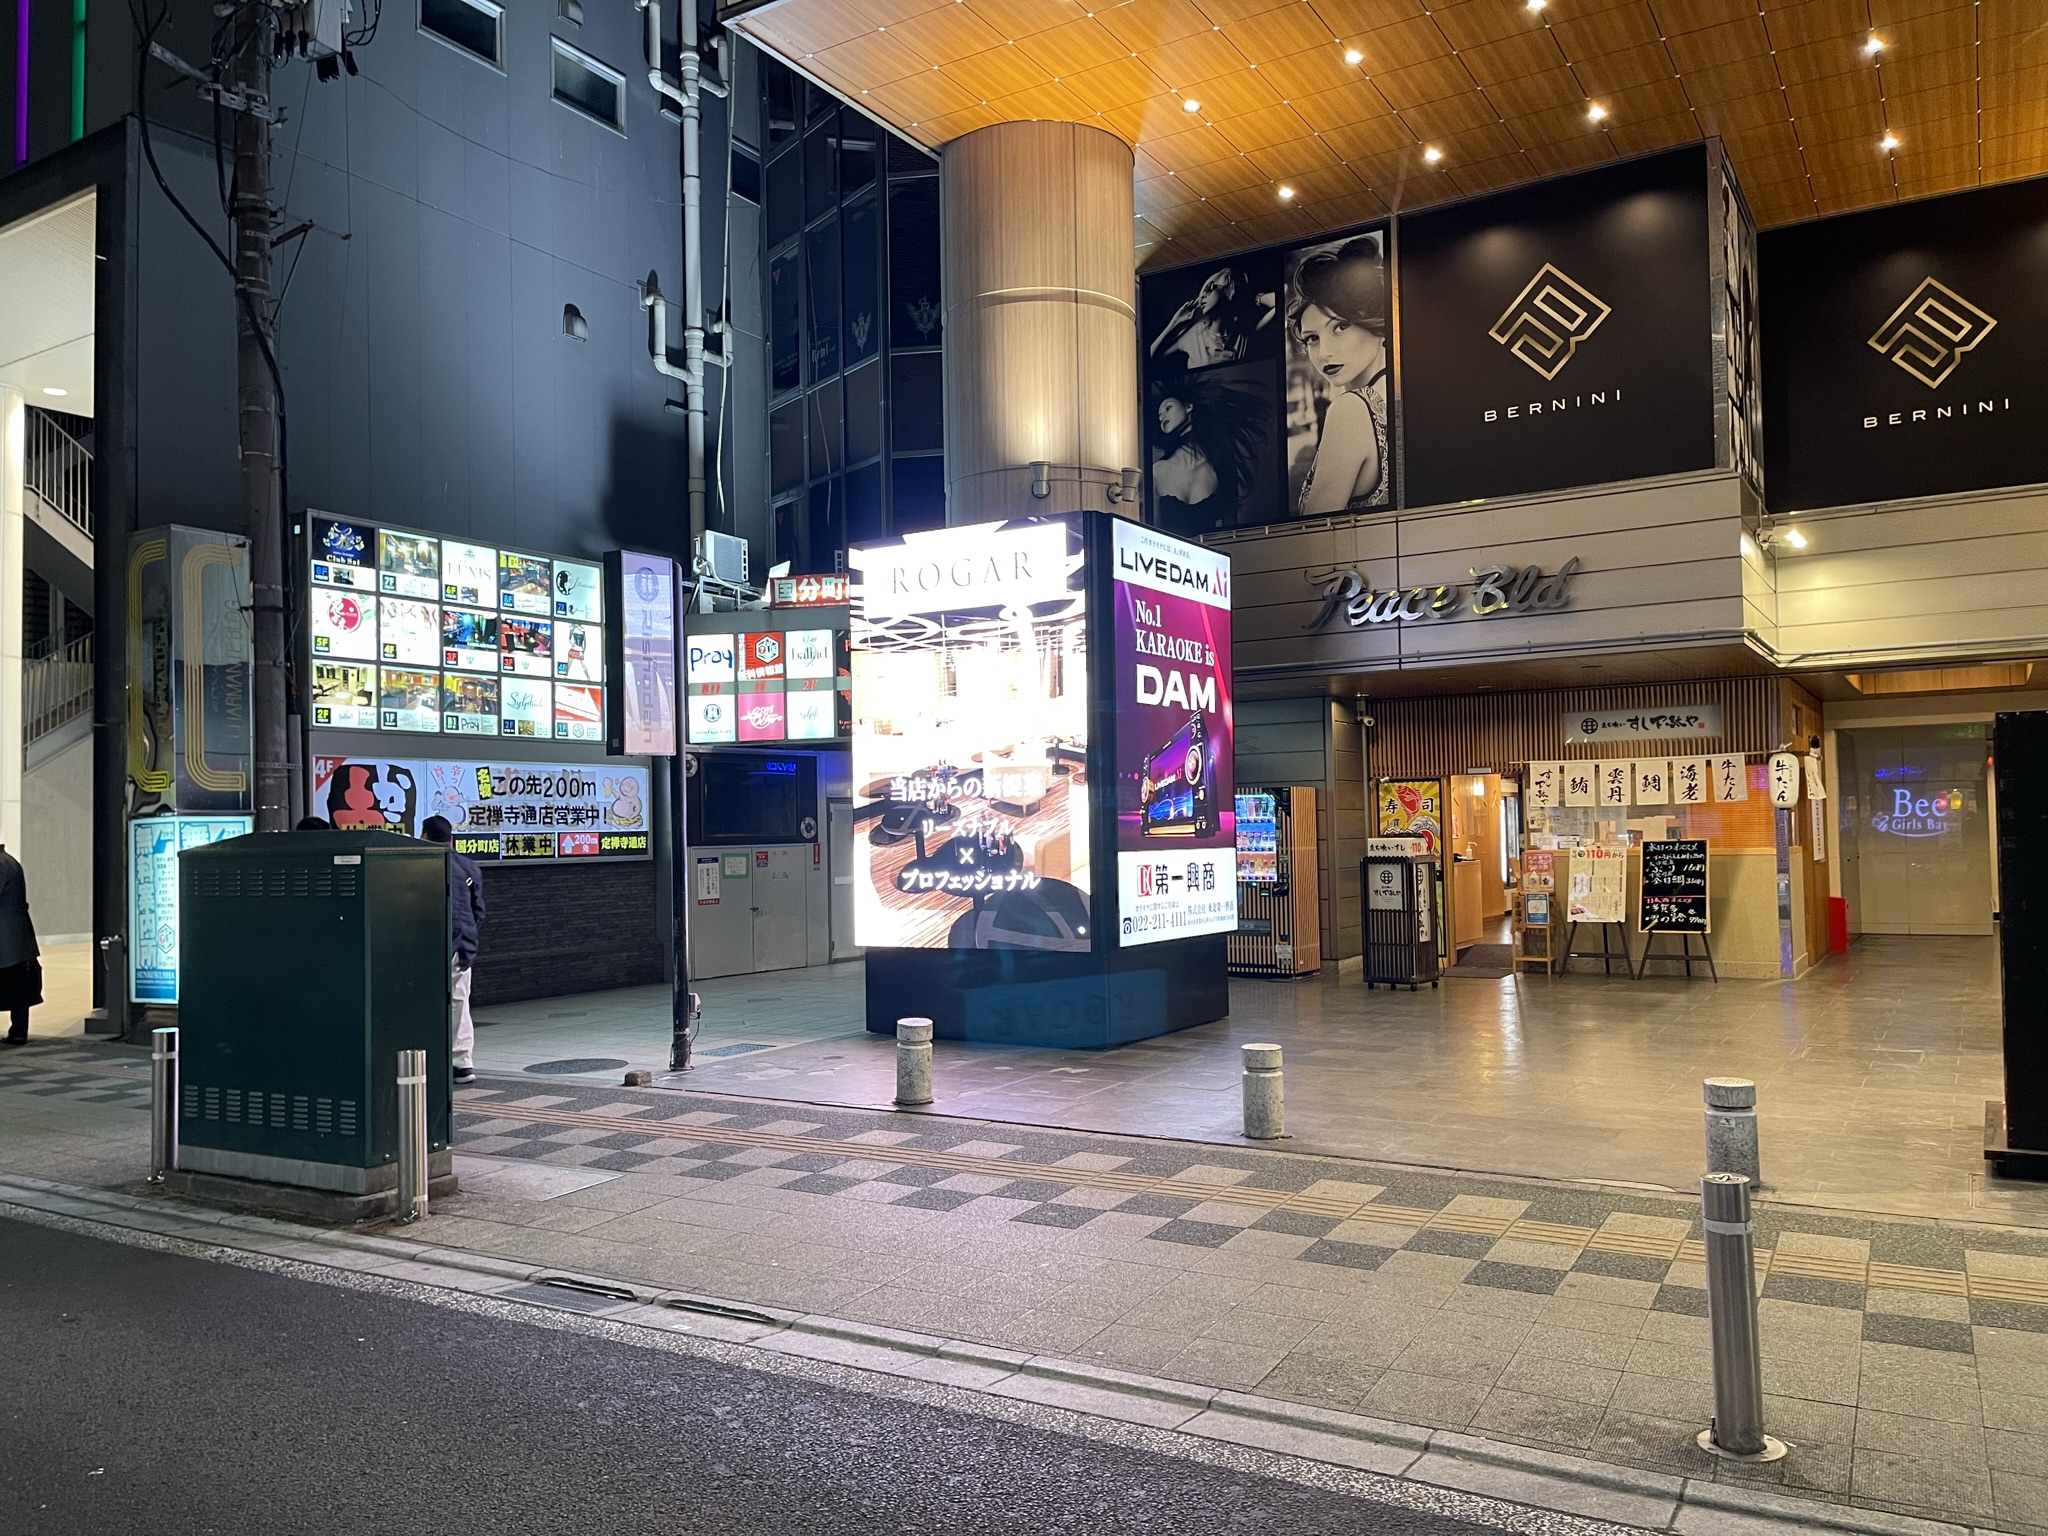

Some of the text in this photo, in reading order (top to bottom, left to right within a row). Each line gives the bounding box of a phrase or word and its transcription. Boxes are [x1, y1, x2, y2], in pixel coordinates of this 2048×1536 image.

[1484, 389, 1620, 422] BERNINI
[1863, 398, 2009, 429] BERNINI
[893, 551, 1032, 594] ROGAR
[1121, 547, 1227, 598] LIVEDAM Ai
[1301, 555, 1579, 631] Peace Bld
[1135, 599, 1162, 628] No.1
[690, 647, 733, 672] Pray
[1135, 629, 1215, 667] KARAOKE is
[1136, 664, 1216, 713] DAM
[461, 717, 480, 732] Pray
[315, 759, 334, 779] 4F
[477, 768, 492, 798] 名物
[1679, 763, 1699, 801] 海老
[1721, 758, 1737, 801] 牛たん
[1775, 759, 1790, 802] 牛たん
[491, 775, 597, 798] この先200m
[1385, 797, 1434, 815] 寿 司
[1892, 818, 1923, 830] Girls
[455, 838, 500, 854] 国分町店
[505, 833, 551, 853] 休業中
[574, 834, 598, 845] 200m
[901, 868, 1041, 891] プロフェッショナル
[1155, 861, 1215, 895] 第一興商
[1132, 911, 1187, 933] 022-211-4111
